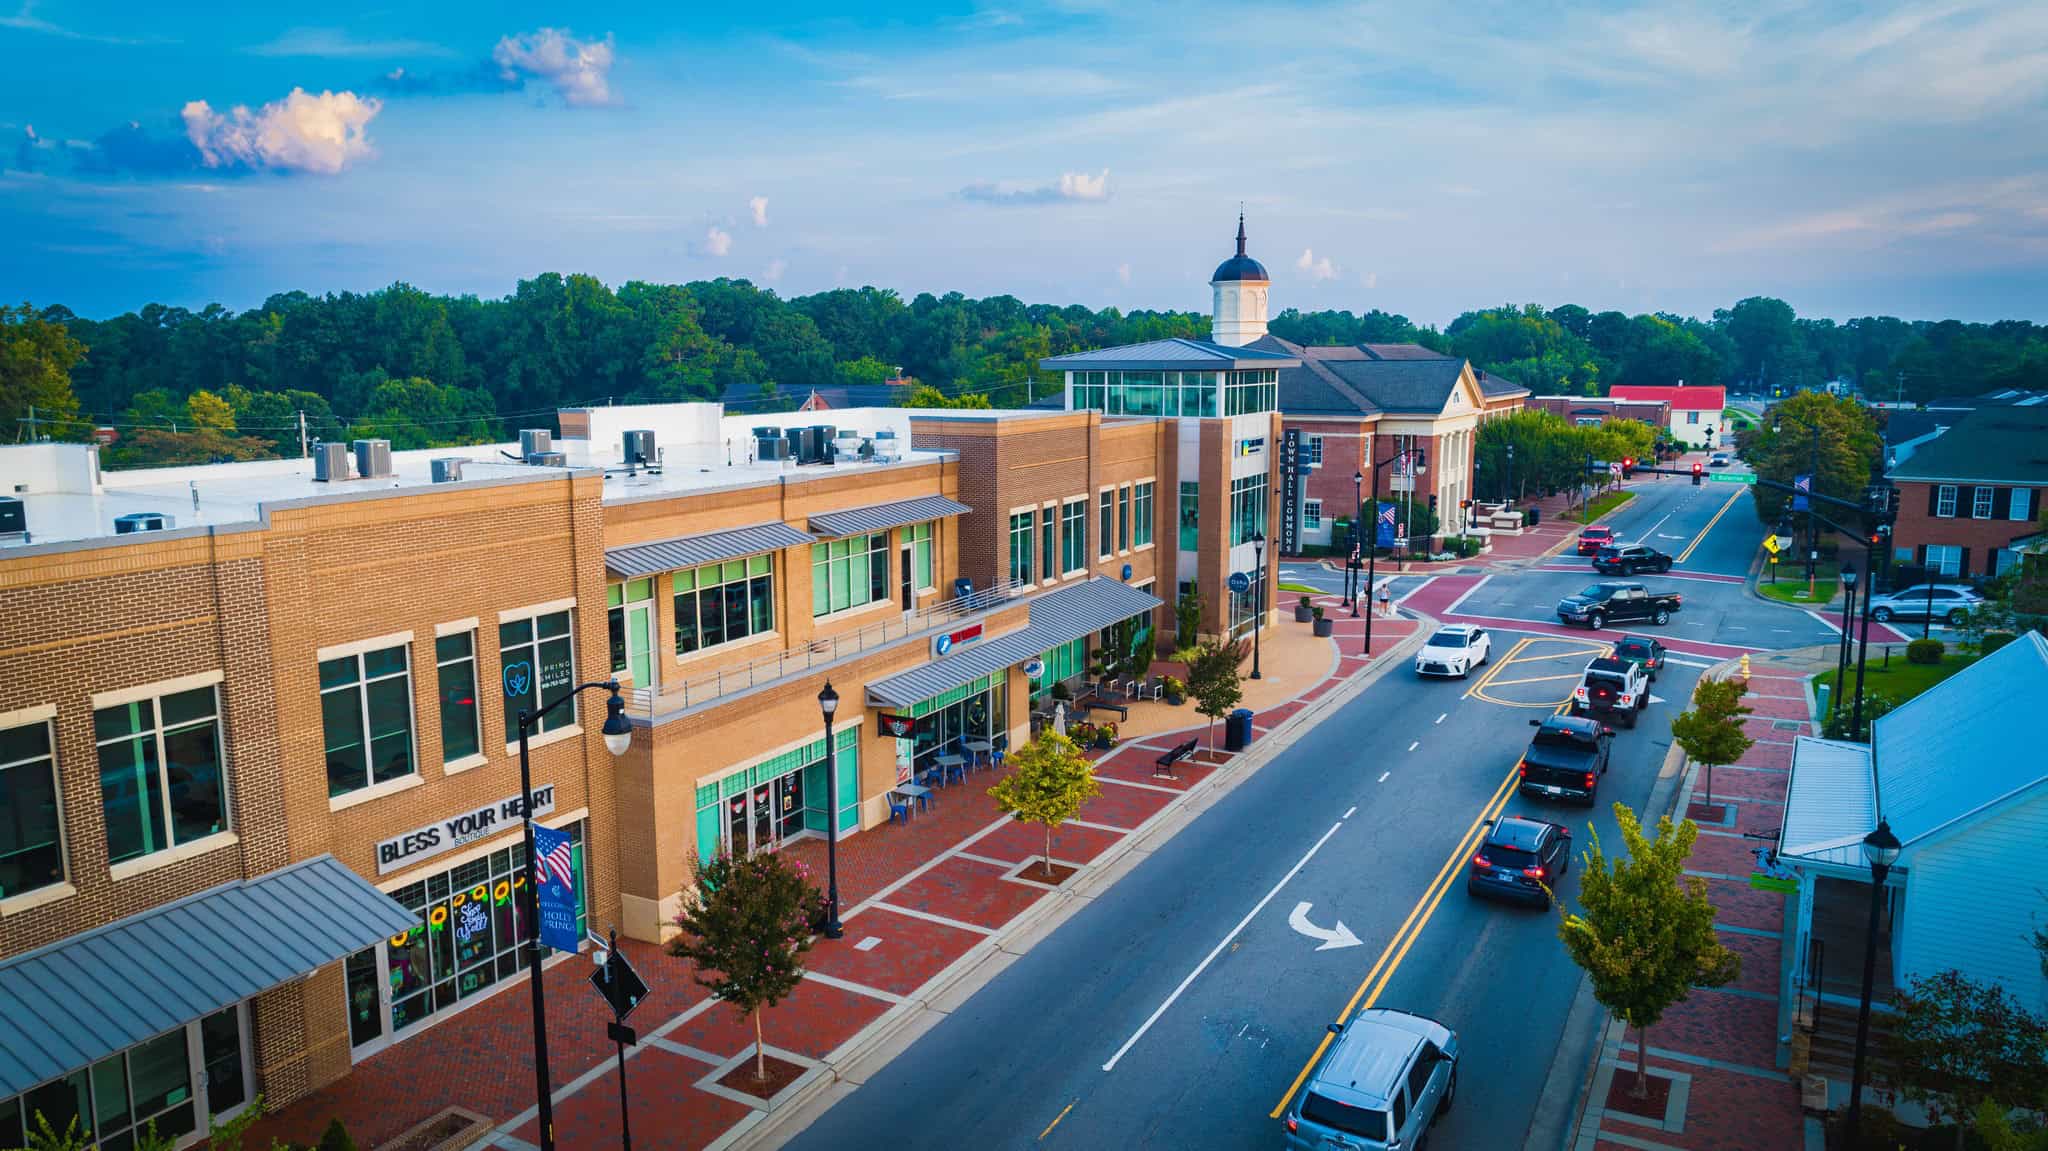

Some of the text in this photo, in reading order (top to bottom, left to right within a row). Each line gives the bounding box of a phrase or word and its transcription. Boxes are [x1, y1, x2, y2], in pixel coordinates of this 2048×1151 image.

[1285, 431, 1296, 553] TOWN HALL COMMONS
[380, 786, 554, 865] BLESS YOUR HERT
